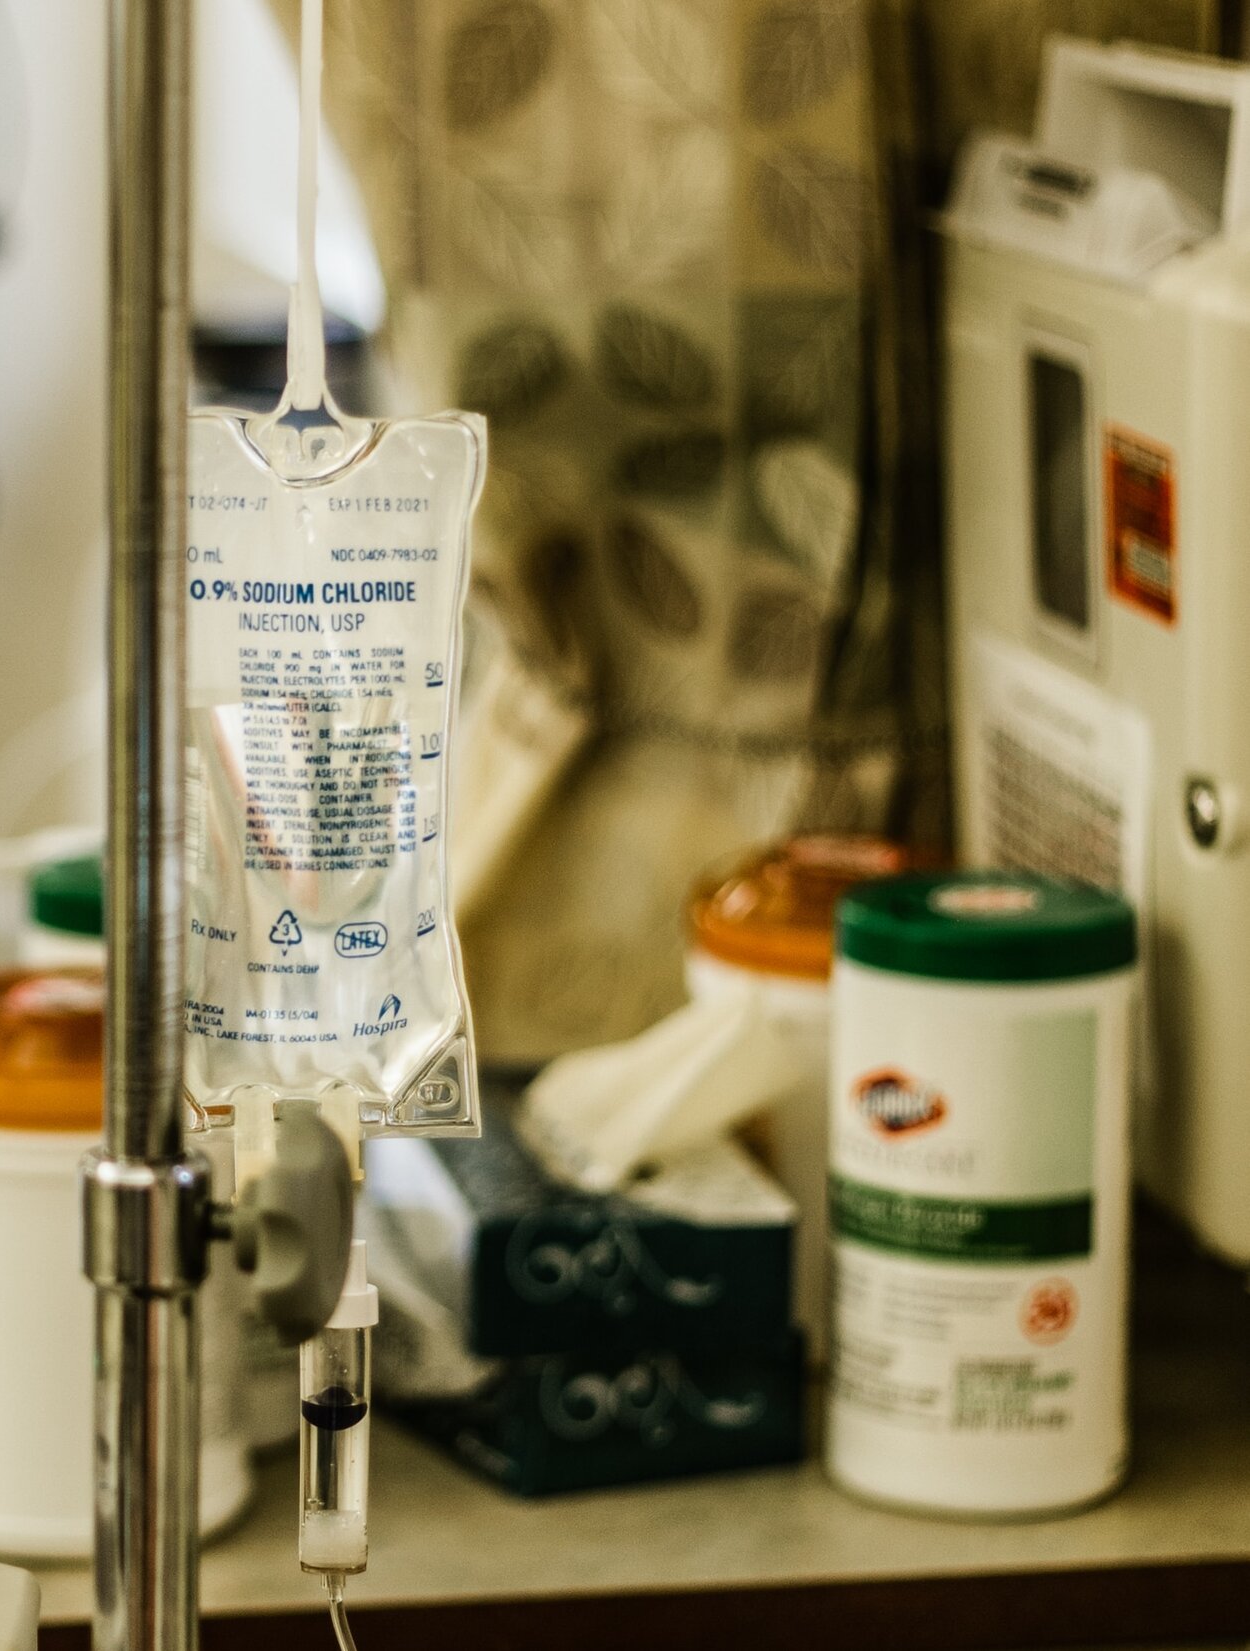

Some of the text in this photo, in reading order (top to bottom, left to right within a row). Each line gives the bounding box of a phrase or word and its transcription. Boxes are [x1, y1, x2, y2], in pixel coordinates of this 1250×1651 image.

[329, 498, 351, 511] EXP
[365, 498, 391, 512] FEB
[396, 498, 430, 512] 2021
[203, 547, 223, 563] mL
[331, 549, 438, 562] NDC 0409-7983-02
[190, 579, 416, 604] 0.9% SODIUM CHLORIDE
[238, 613, 366, 635] INJECTION, USP
[313, 648, 360, 659] CONTAINS
[371, 648, 404, 657] SODIUM
[351, 661, 382, 671] WATER
[390, 660, 405, 670] FOR
[425, 662, 443, 680] 50
[284, 676, 346, 685] ELECTROLYTES
[350, 675, 366, 684] PER
[371, 674, 390, 683] 1000
[310, 689, 353, 699] CHLORIDE
[291, 729, 310, 738] MAY
[319, 728, 330, 739] BE
[305, 755, 331, 765] WHEN
[350, 751, 411, 763] INTRODUCING
[315, 768, 353, 778] ASEPTIC
[319, 782, 338, 791] AND
[343, 781, 356, 790] DO
[360, 779, 377, 788] NOT
[397, 790, 416, 799] FOR
[325, 808, 353, 817] USUAL
[401, 803, 415, 813] SEE
[399, 816, 415, 826] USE
[359, 832, 388, 842] CLEAR
[397, 830, 416, 839] AND
[370, 844, 395, 854] MUST
[399, 841, 416, 852] NOT
[258, 860, 281, 870] USED
[208, 927, 237, 941] ONLY
[341, 930, 381, 951] LATEX
[247, 962, 320, 974] CONTAINS DEHP
[201, 1003, 224, 1015] 2004
[192, 1014, 201, 1023] IN
[203, 1016, 223, 1027] USA
[353, 1017, 408, 1037] Hospira
[216, 1029, 239, 1040] LAKE
[319, 1033, 338, 1042] USA
